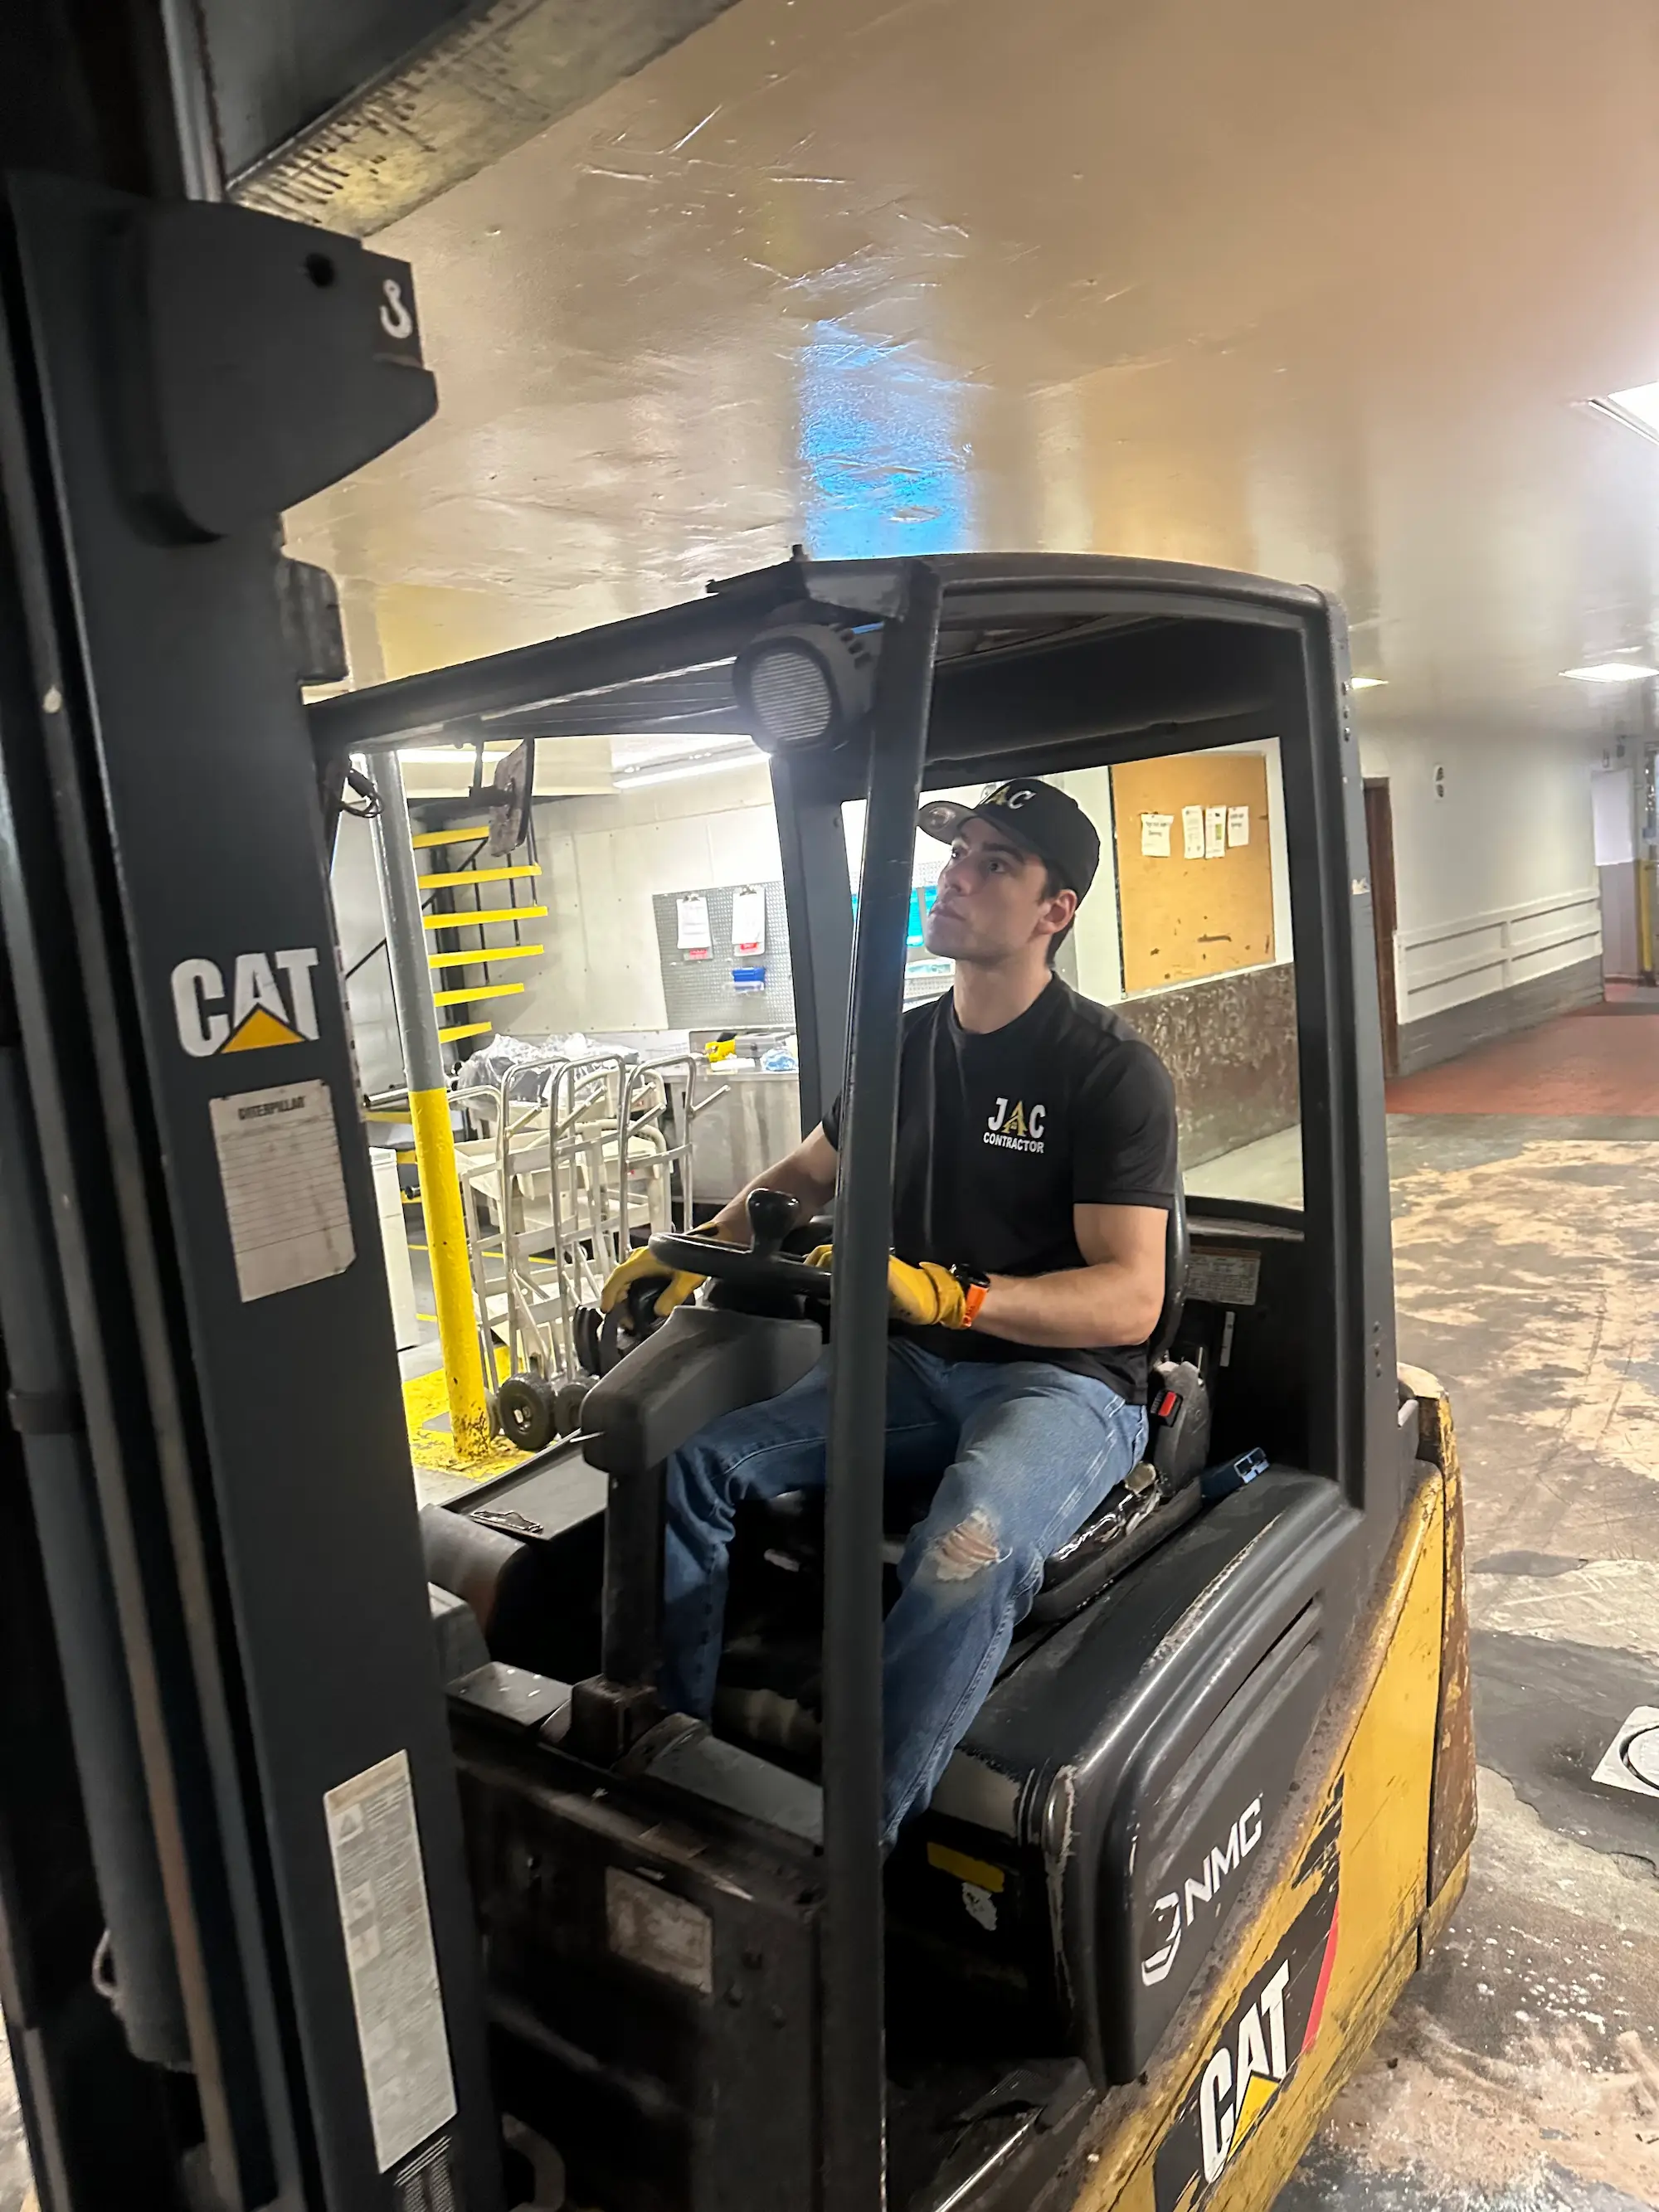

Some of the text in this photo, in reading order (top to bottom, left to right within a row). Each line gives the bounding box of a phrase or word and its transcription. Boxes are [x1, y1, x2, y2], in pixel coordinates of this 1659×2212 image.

[171, 947, 320, 1058] CAT
[982, 1131, 1045, 1154] CONTRACTOR
[987, 1097, 1046, 1140] JAC
[1199, 1958, 1290, 2184] CAT
